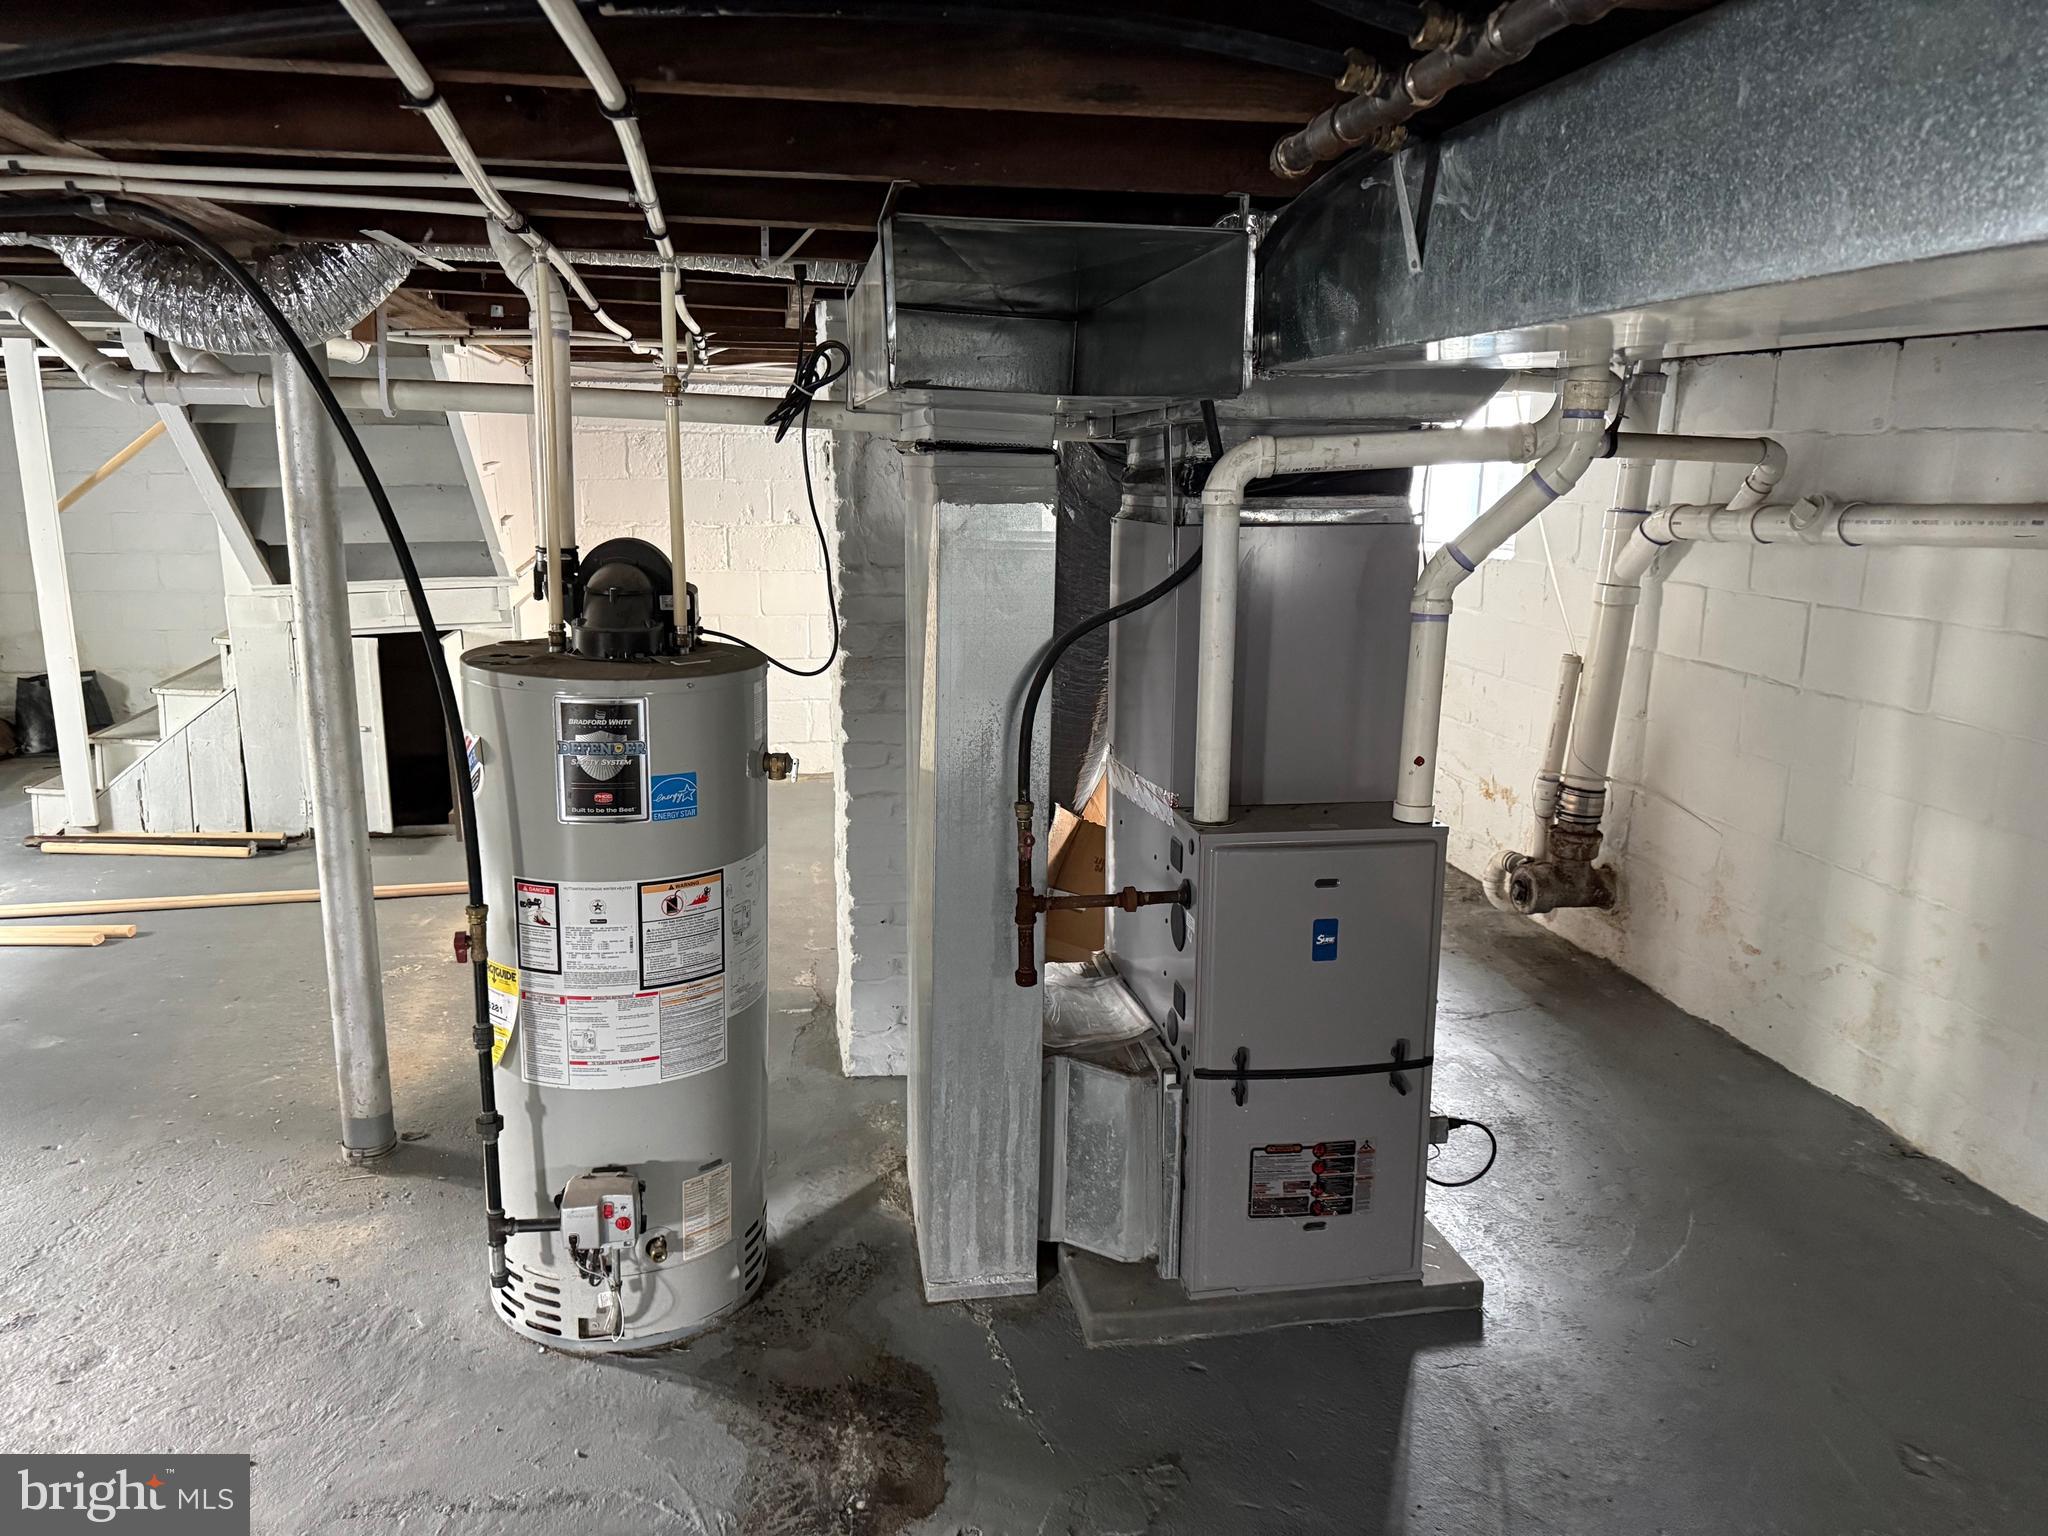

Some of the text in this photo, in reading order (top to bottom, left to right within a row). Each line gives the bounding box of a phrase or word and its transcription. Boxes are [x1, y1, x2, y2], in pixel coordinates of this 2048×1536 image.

[568, 718, 634, 726] BRADFORD WHITE
[558, 741, 647, 757] DEFENDER
[601, 759, 632, 767] SYSTEM
[653, 808, 696, 820] ENERGY STAR
[674, 880, 700, 889] WARNING
[528, 886, 550, 894] DANGER
